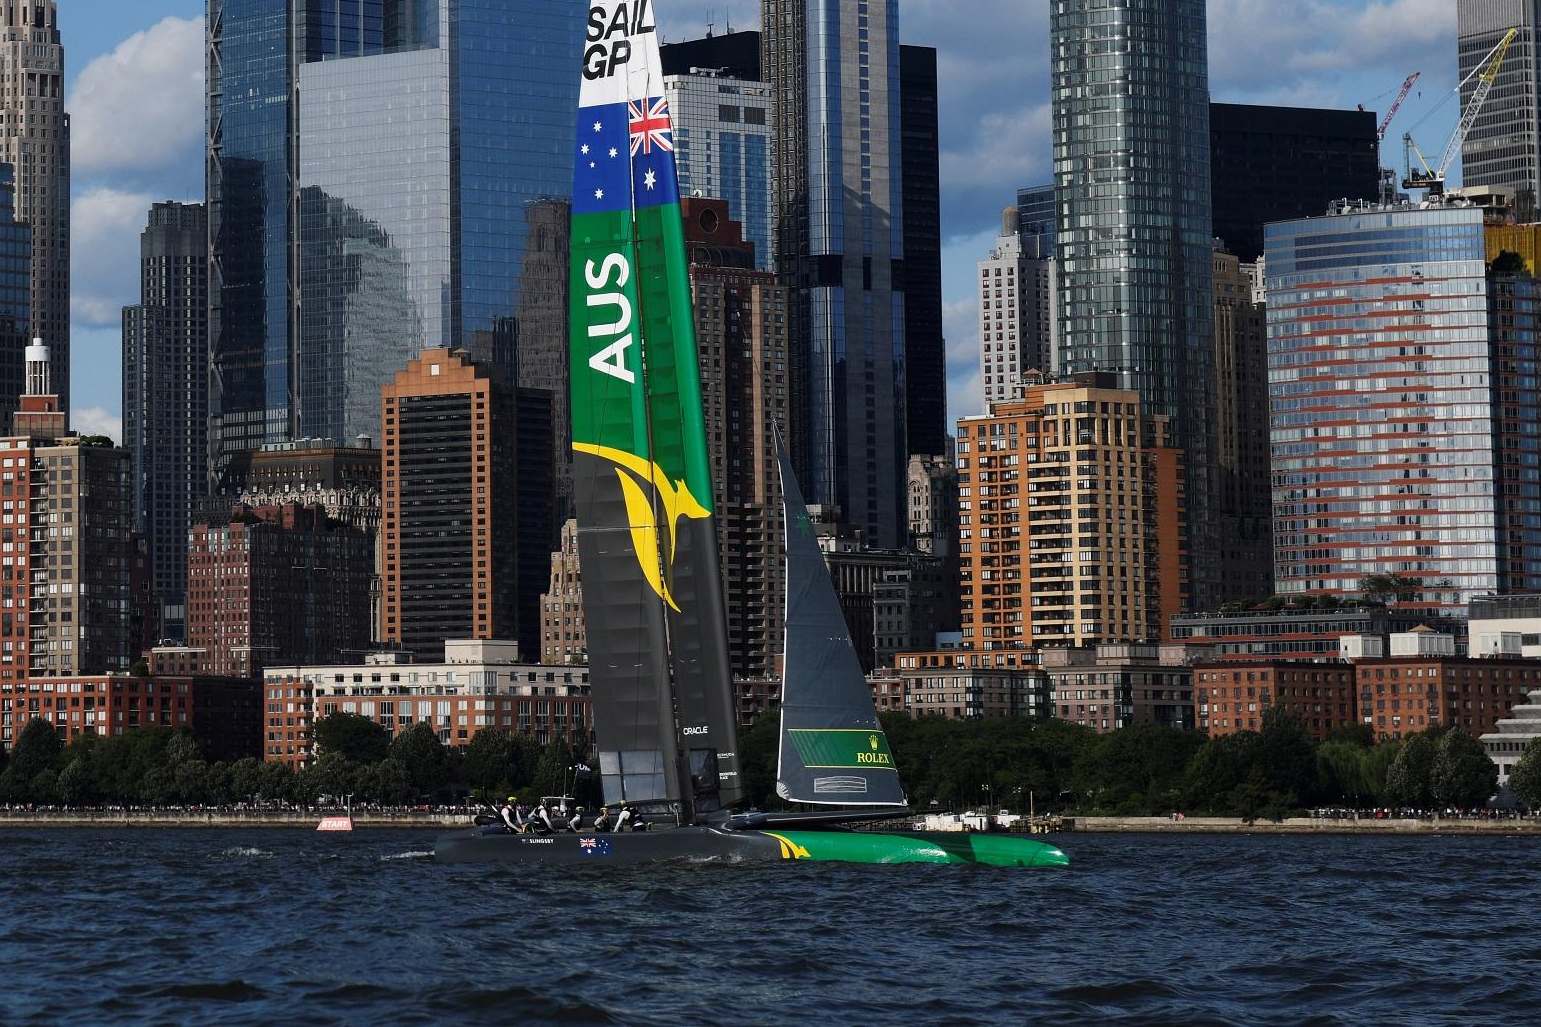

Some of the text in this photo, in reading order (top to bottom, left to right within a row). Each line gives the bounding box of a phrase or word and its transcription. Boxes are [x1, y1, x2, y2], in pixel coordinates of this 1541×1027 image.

[583, 40, 632, 80] GP
[585, 252, 635, 384] AUS
[683, 726, 709, 735] ORACLE
[856, 752, 890, 764] ROLEX
[321, 820, 349, 828] START
